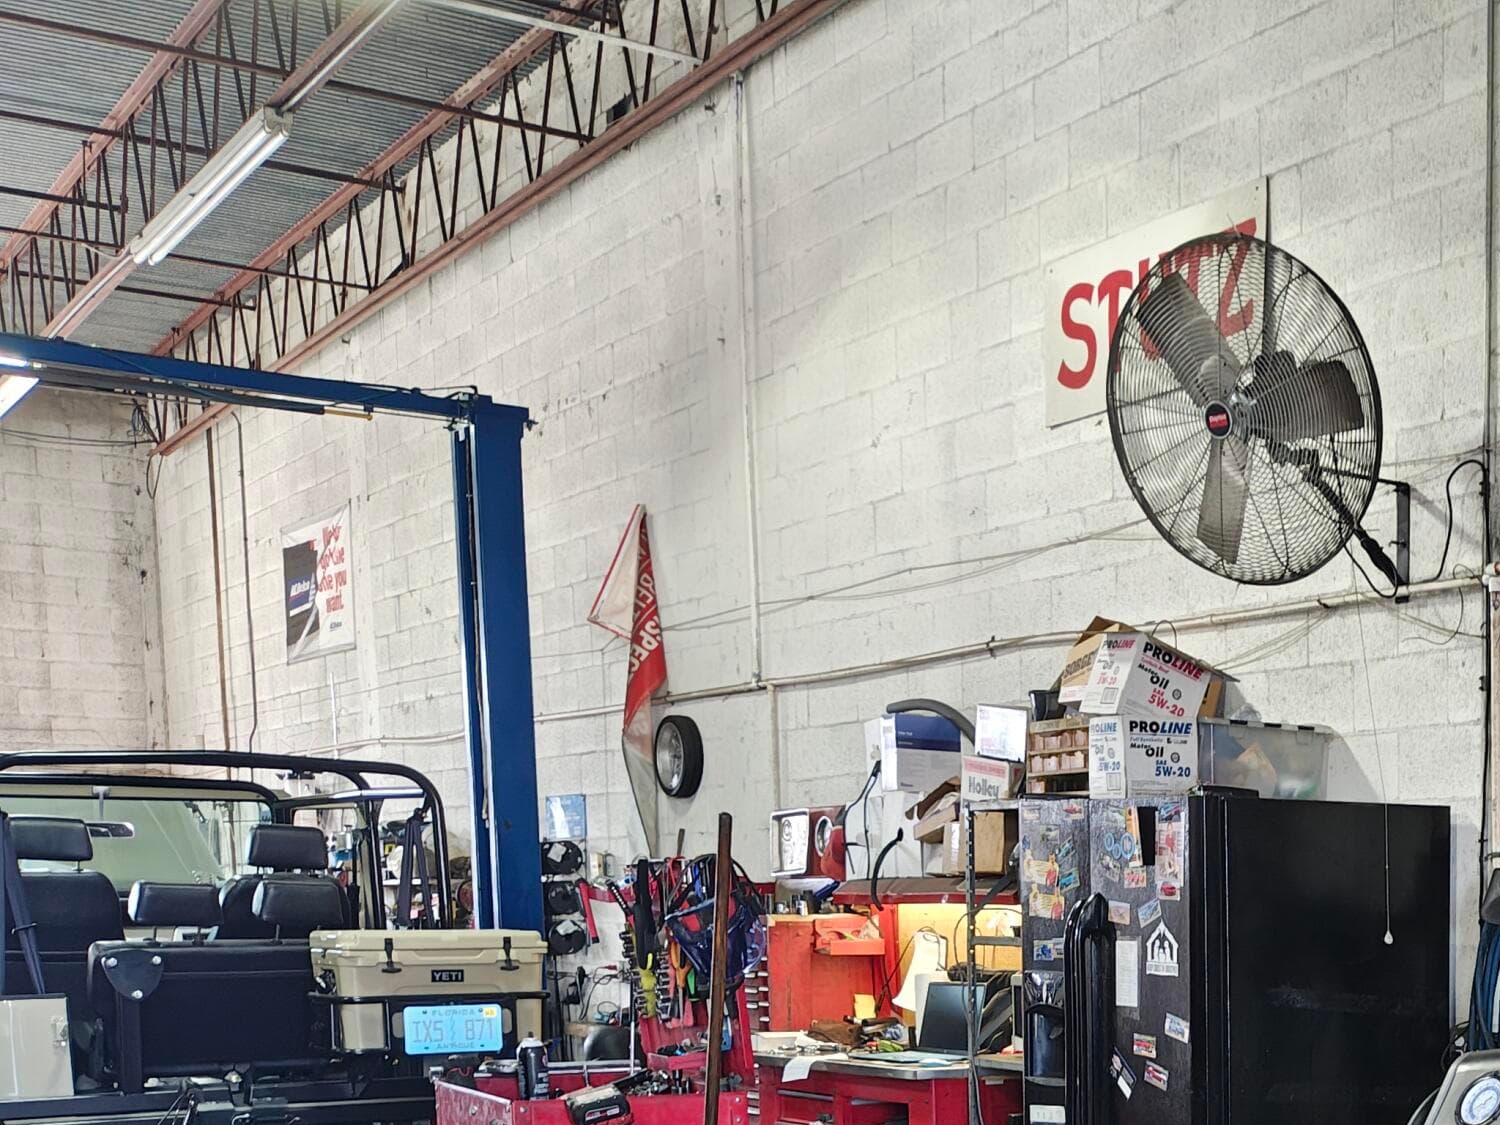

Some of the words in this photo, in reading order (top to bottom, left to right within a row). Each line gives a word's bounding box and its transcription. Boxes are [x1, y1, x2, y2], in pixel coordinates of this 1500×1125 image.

[1143, 642, 1205, 680] PROLINE
[1150, 674, 1169, 690] Oil
[1148, 694, 1185, 717] 5W-20
[1129, 720, 1192, 734] PROLINE
[1145, 746, 1164, 757] Oil
[1155, 766, 1191, 778] 5W-20
[968, 776, 1000, 799] Holley
[433, 971, 462, 981] YETI
